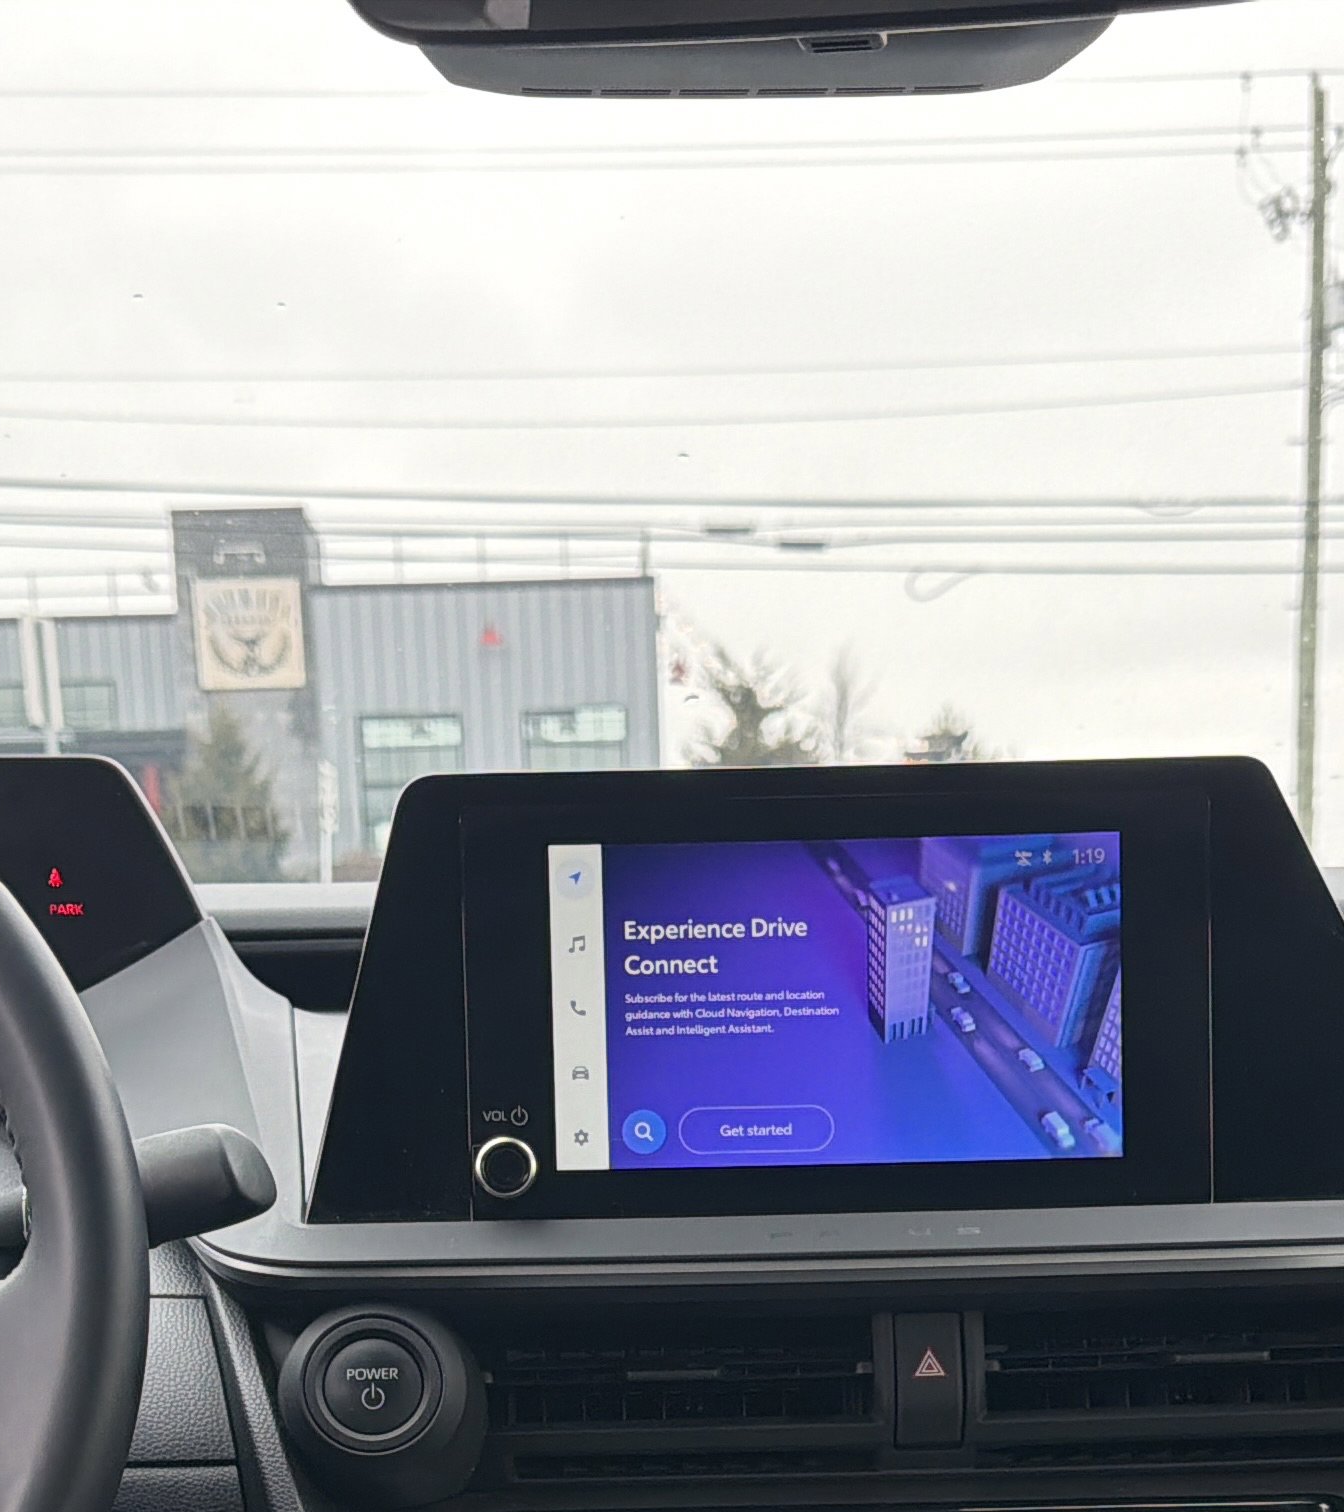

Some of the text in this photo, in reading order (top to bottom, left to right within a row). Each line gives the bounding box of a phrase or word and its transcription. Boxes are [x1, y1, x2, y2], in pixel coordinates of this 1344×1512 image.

[1072, 846, 1106, 867] 1:19
[49, 903, 85, 916] PARK
[623, 916, 809, 945] Experience Drive
[623, 954, 719, 976] Connect
[624, 989, 825, 1004] Subscribe for the latest route and location
[625, 1006, 840, 1022] guidance with Cloud Navigation, Destination
[625, 1023, 775, 1037] Assist and Intelligent Assistant.
[482, 1109, 508, 1123] VOL
[719, 1119, 793, 1139] Get started
[345, 1367, 399, 1381] POWER
